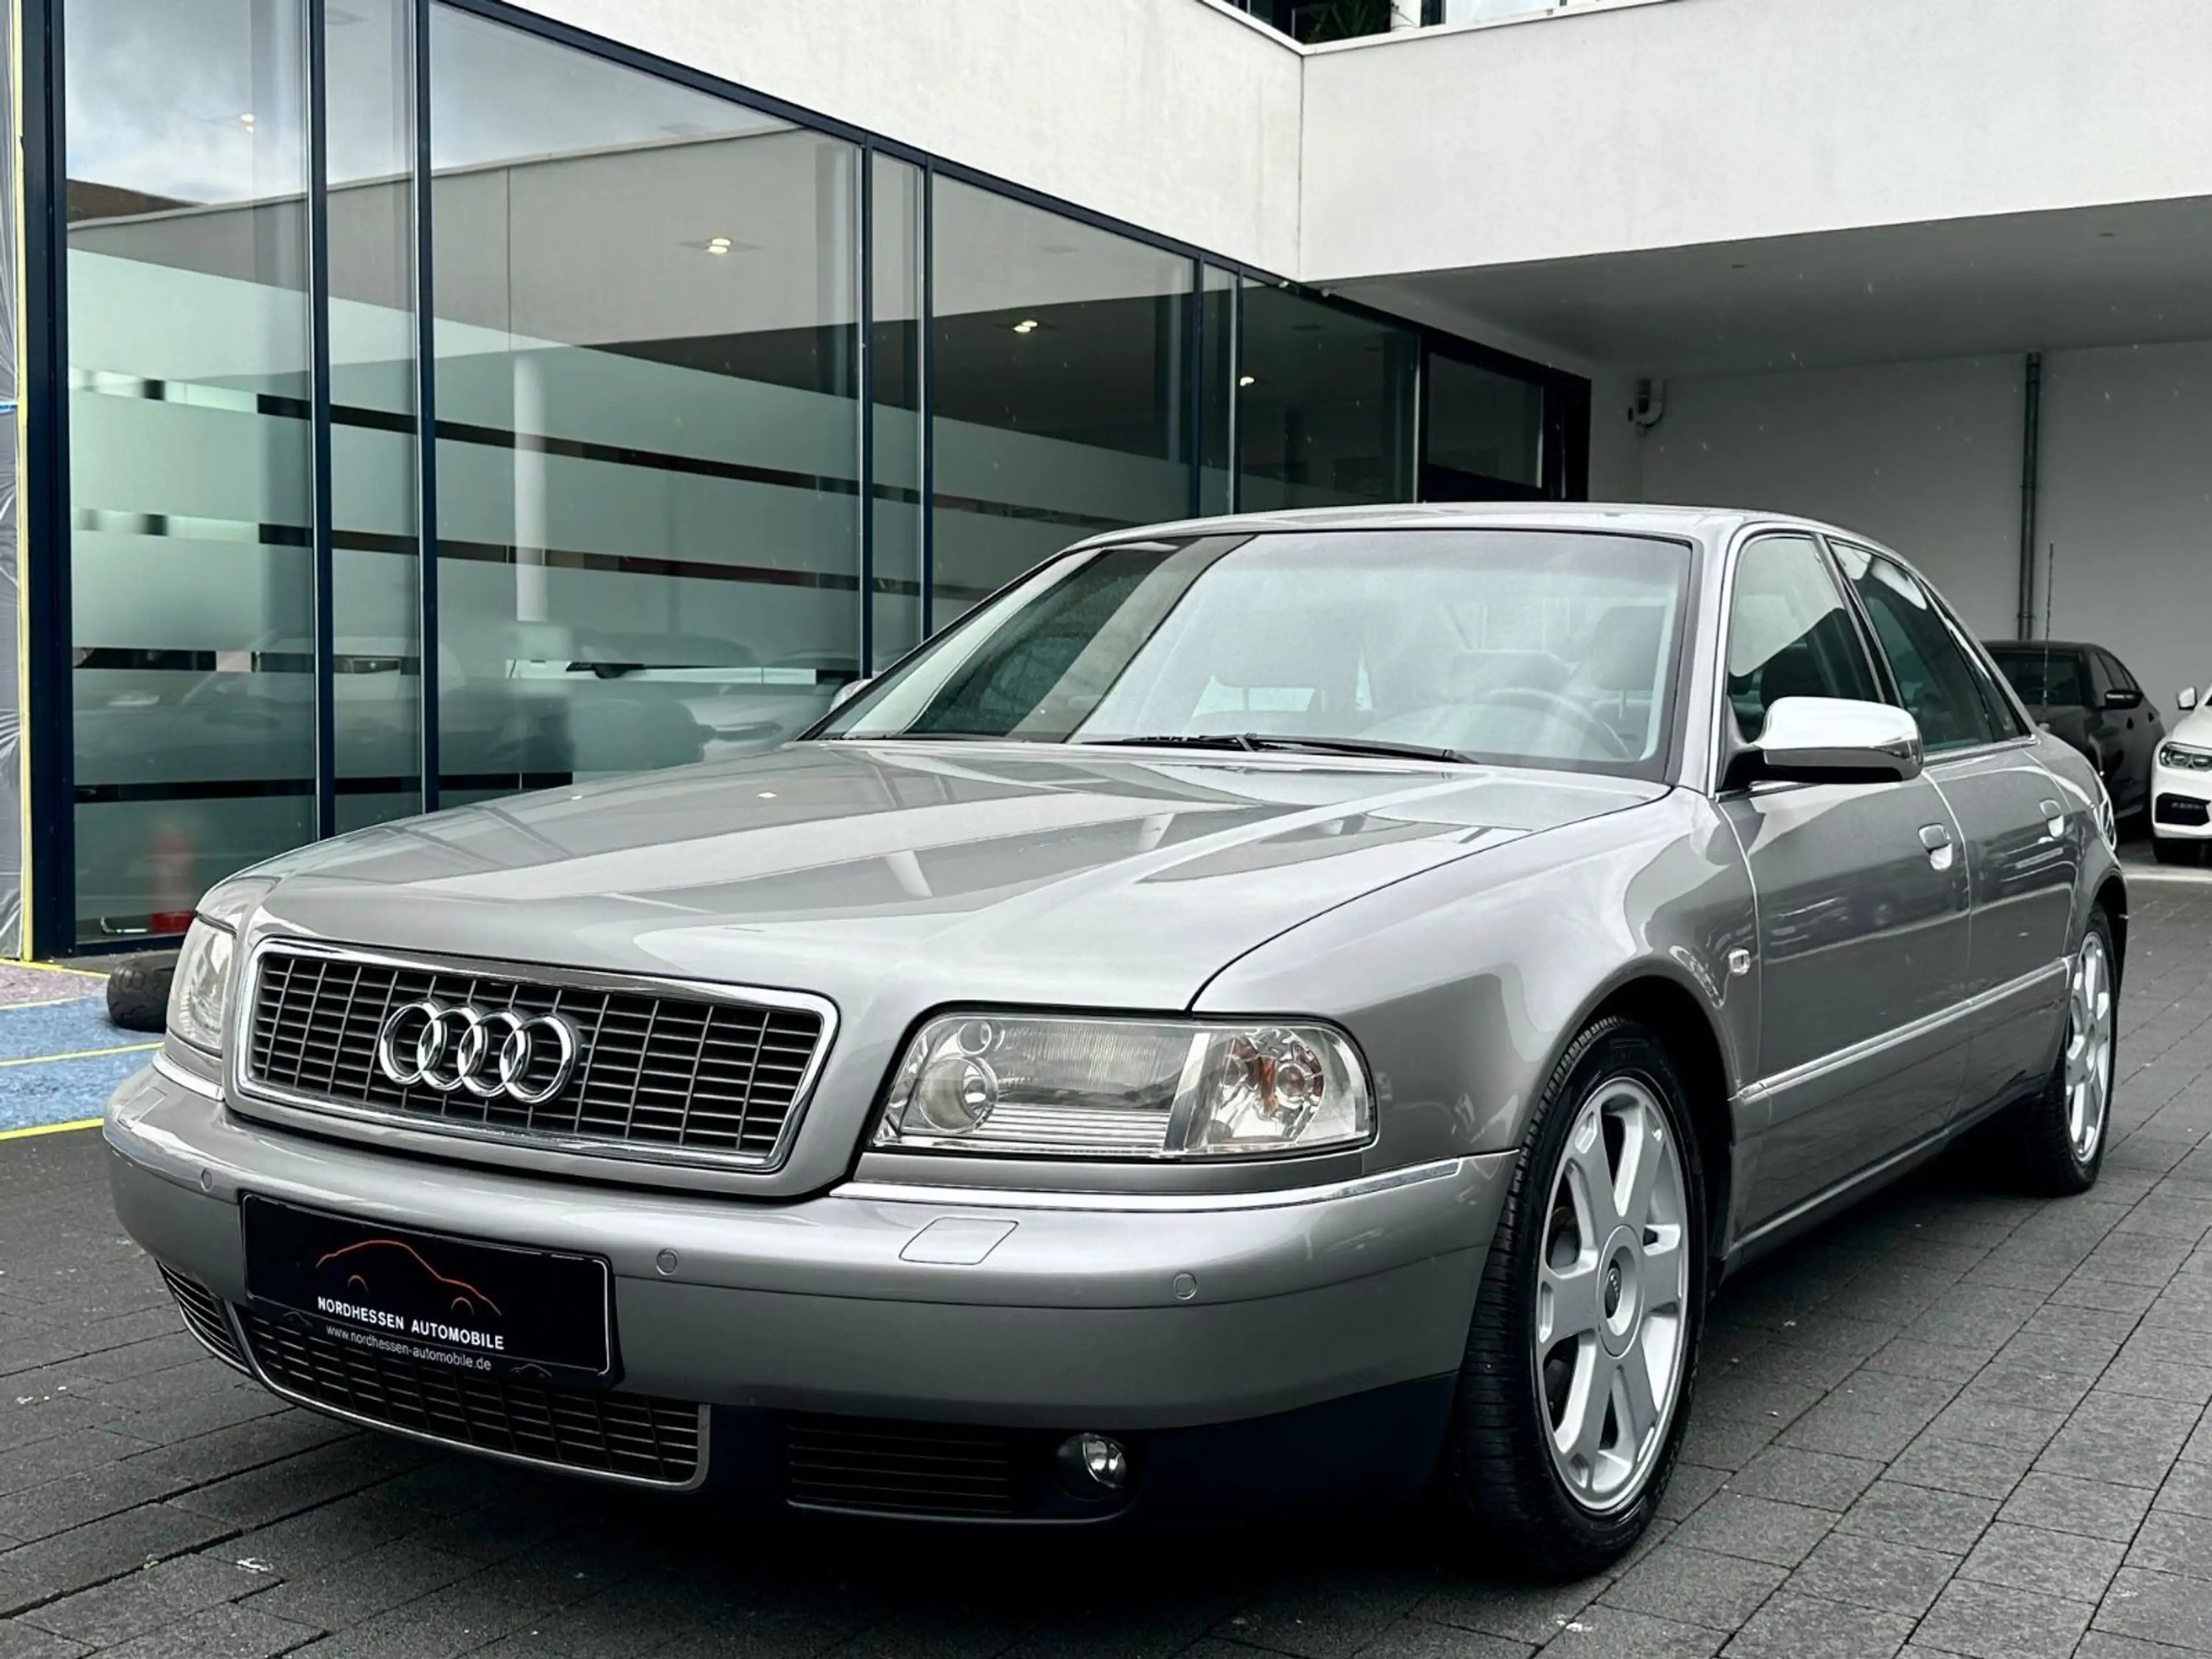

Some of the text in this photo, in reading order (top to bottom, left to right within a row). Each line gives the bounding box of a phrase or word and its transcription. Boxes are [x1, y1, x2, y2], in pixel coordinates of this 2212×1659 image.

[318, 1296, 504, 1350] NORDHESSEN AUTOMOBILE
[326, 1325, 491, 1370] www.nordhessen-automobile.de
